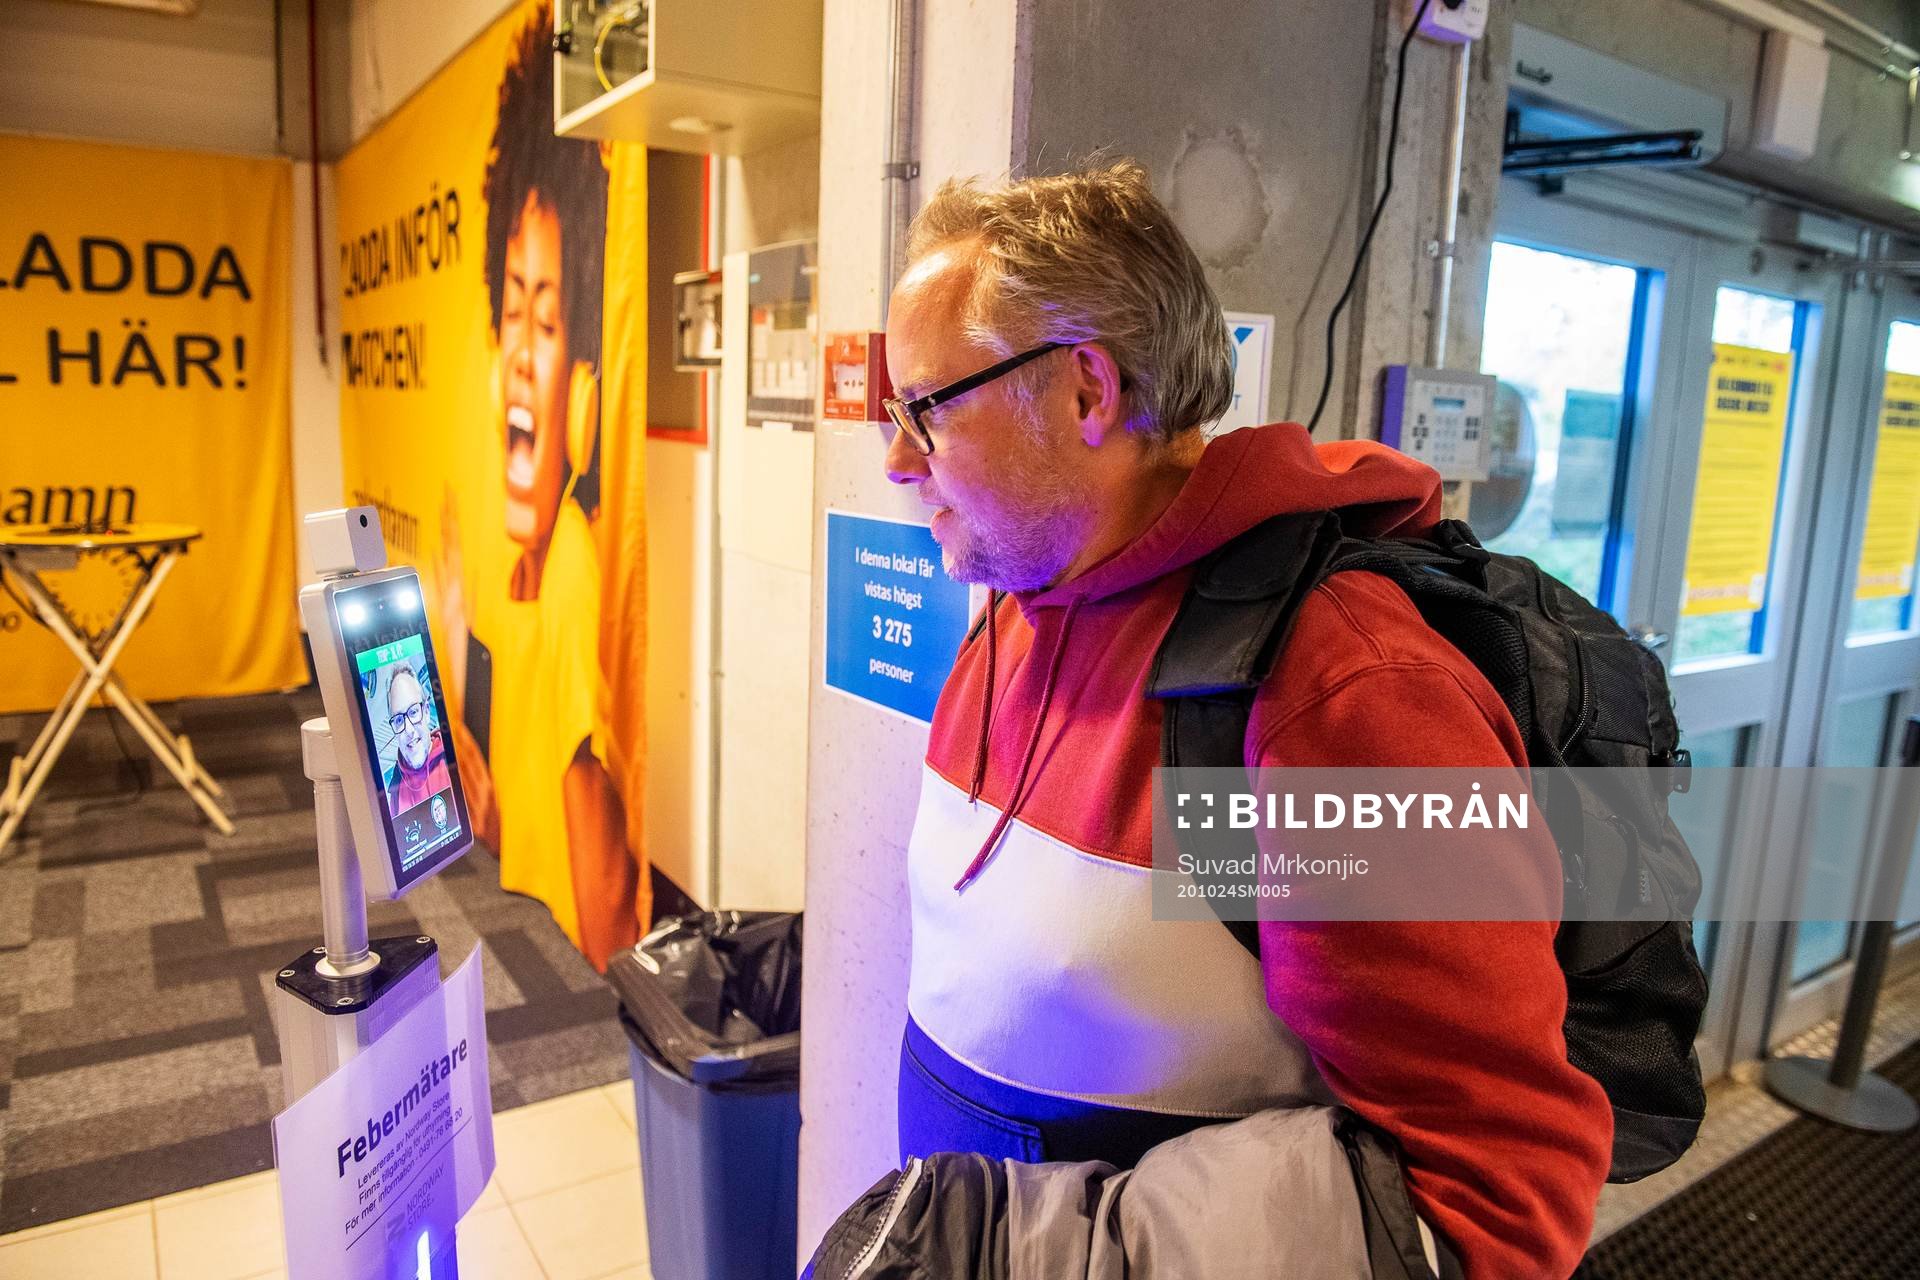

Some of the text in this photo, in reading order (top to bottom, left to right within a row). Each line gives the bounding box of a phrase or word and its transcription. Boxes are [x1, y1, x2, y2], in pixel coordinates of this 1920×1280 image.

[395, 180, 461, 281] INFÖR
[0, 232, 251, 301] ADDA
[48, 319, 248, 389] HÄR!
[855, 546, 935, 578] I denna lokal får
[864, 580, 922, 610] vistas högst
[872, 615, 912, 648] 3 275
[869, 657, 914, 684] personer
[337, 1037, 468, 1178] Febermätare
[358, 1149, 395, 1189] Levereras
[405, 1109, 431, 1142] Nordway
[432, 1091, 450, 1112] Store
[345, 1216, 359, 1235] För
[361, 1199, 376, 1219] mer
[379, 1159, 415, 1203] information
[359, 1179, 381, 1205] Finns
[407, 1162, 444, 1215] NORDWAY
